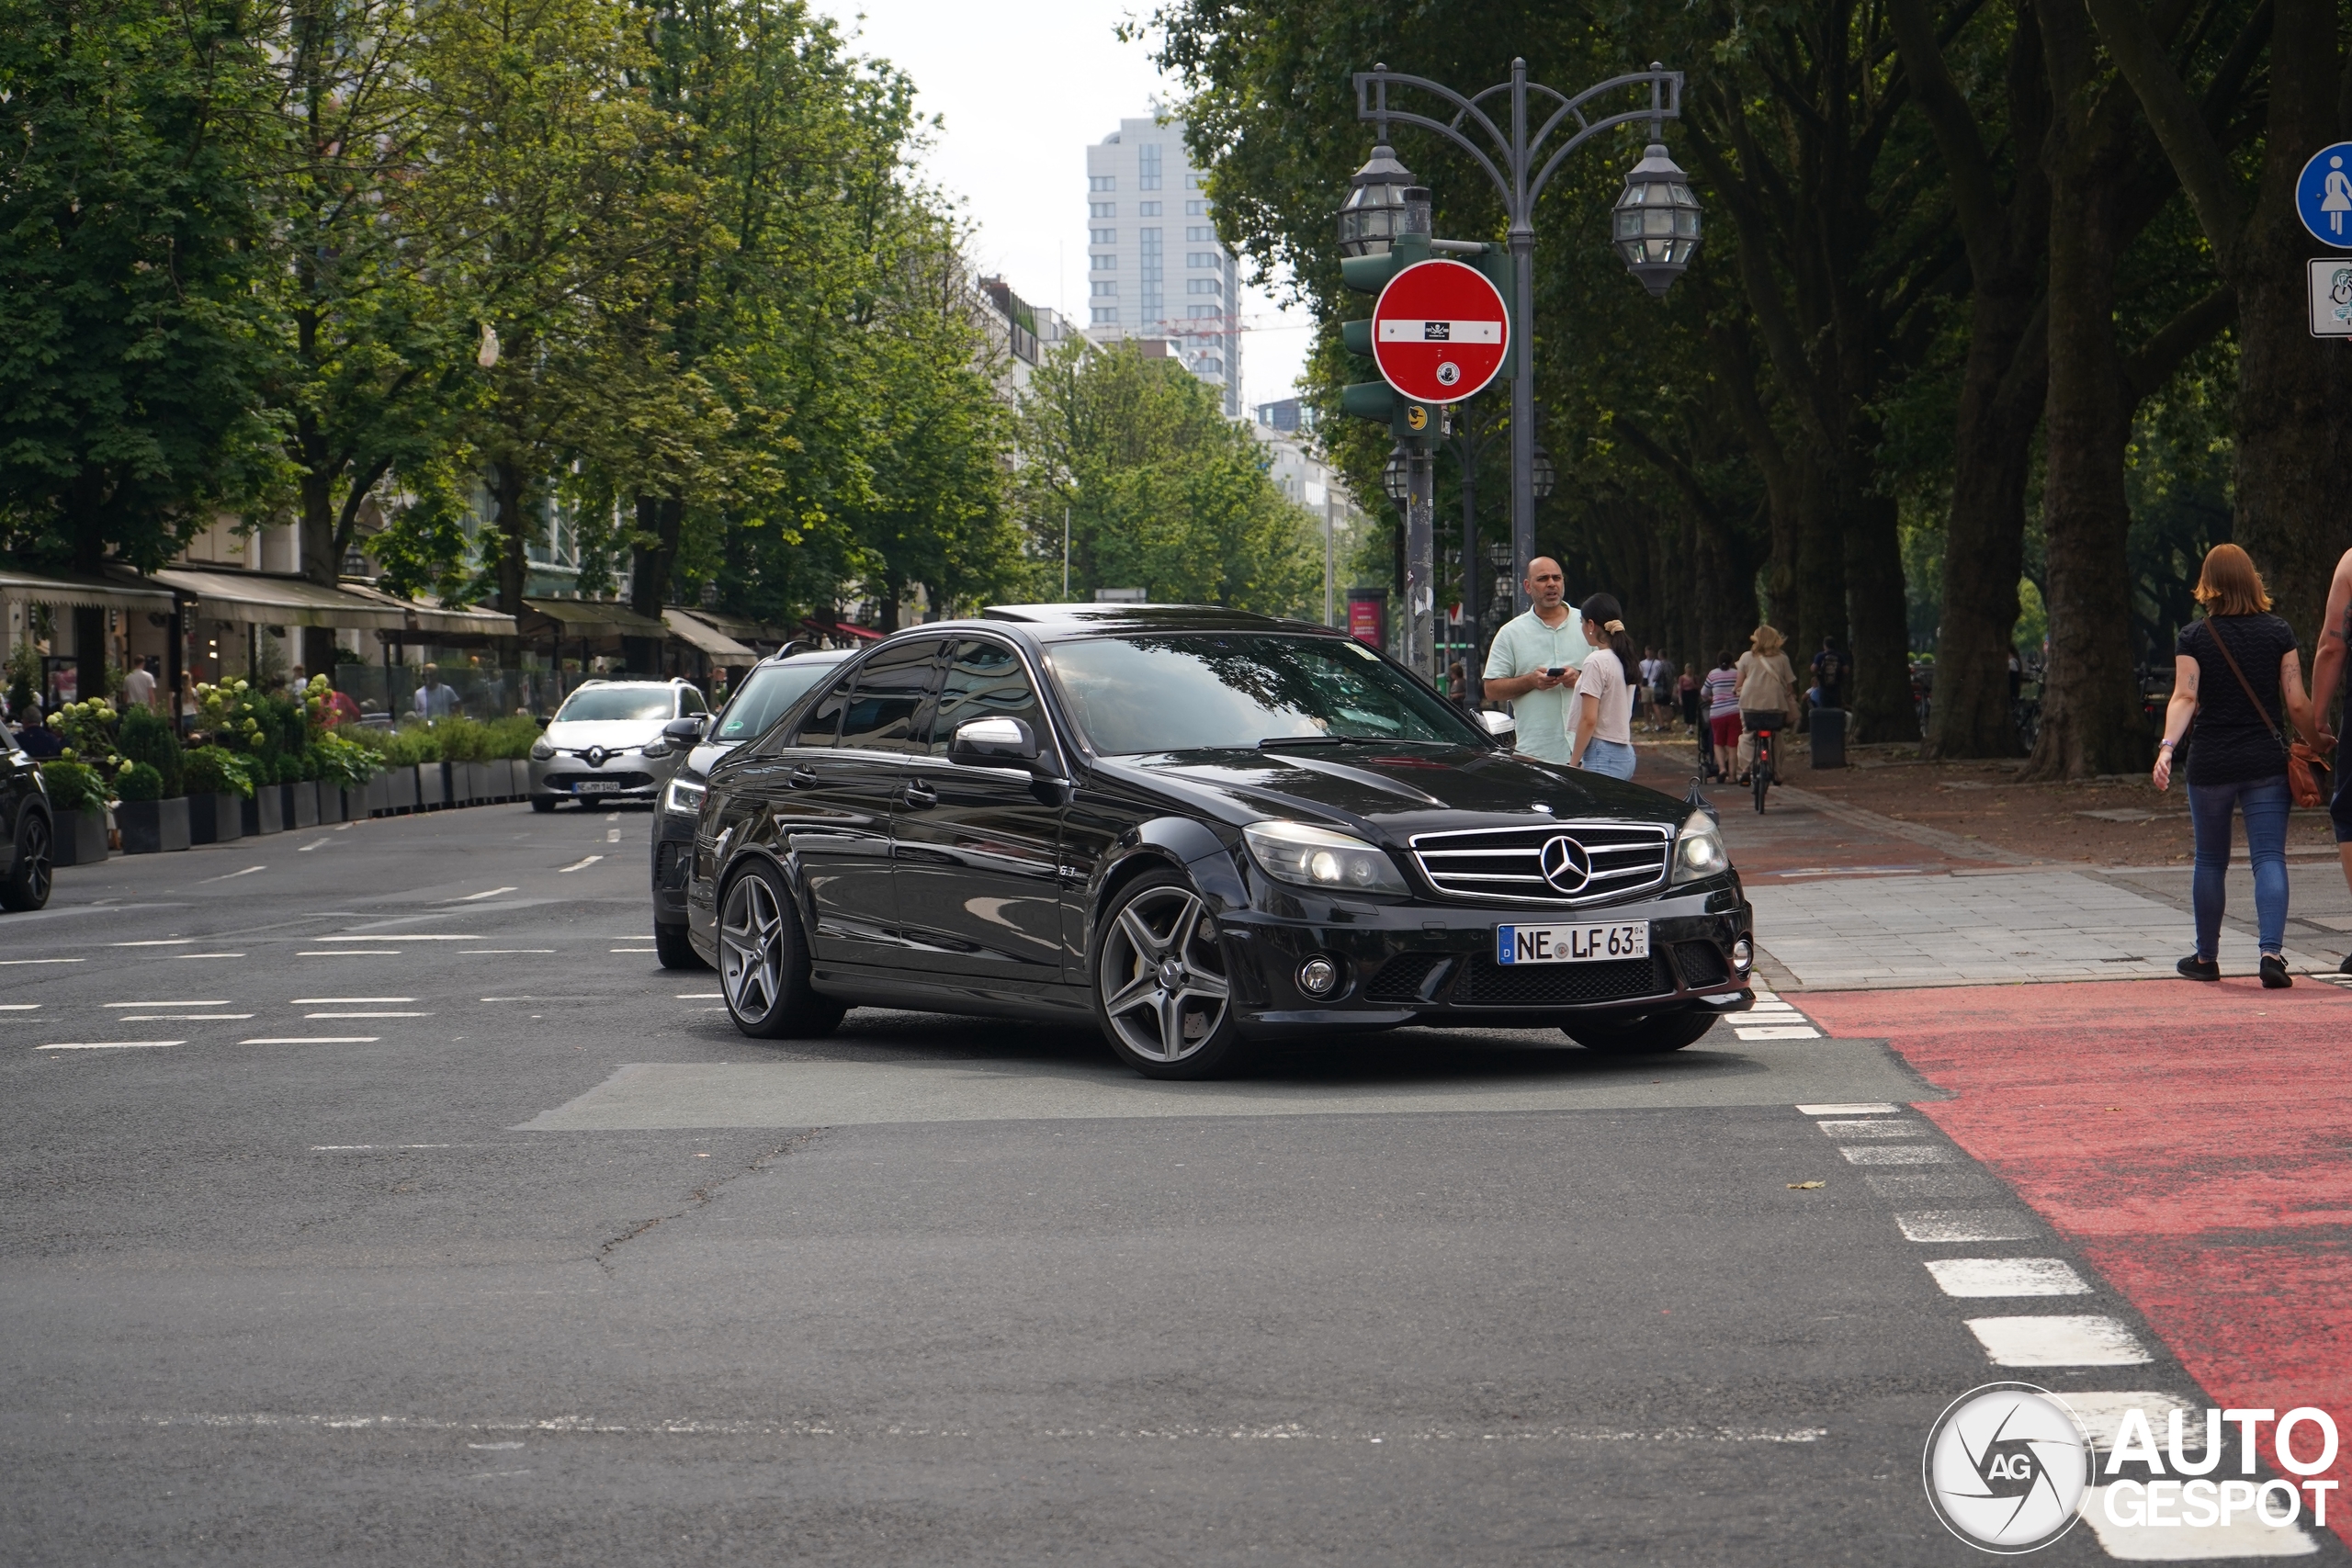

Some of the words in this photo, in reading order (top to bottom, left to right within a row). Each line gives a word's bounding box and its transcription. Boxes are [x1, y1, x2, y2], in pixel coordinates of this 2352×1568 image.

[1634, 926, 1644, 935] 04
[1517, 931, 1553, 961] NE
[1572, 929, 1603, 958] LF
[1608, 926, 1634, 956] 63
[1503, 948, 1511, 958] D
[1635, 945, 1644, 954] 10
